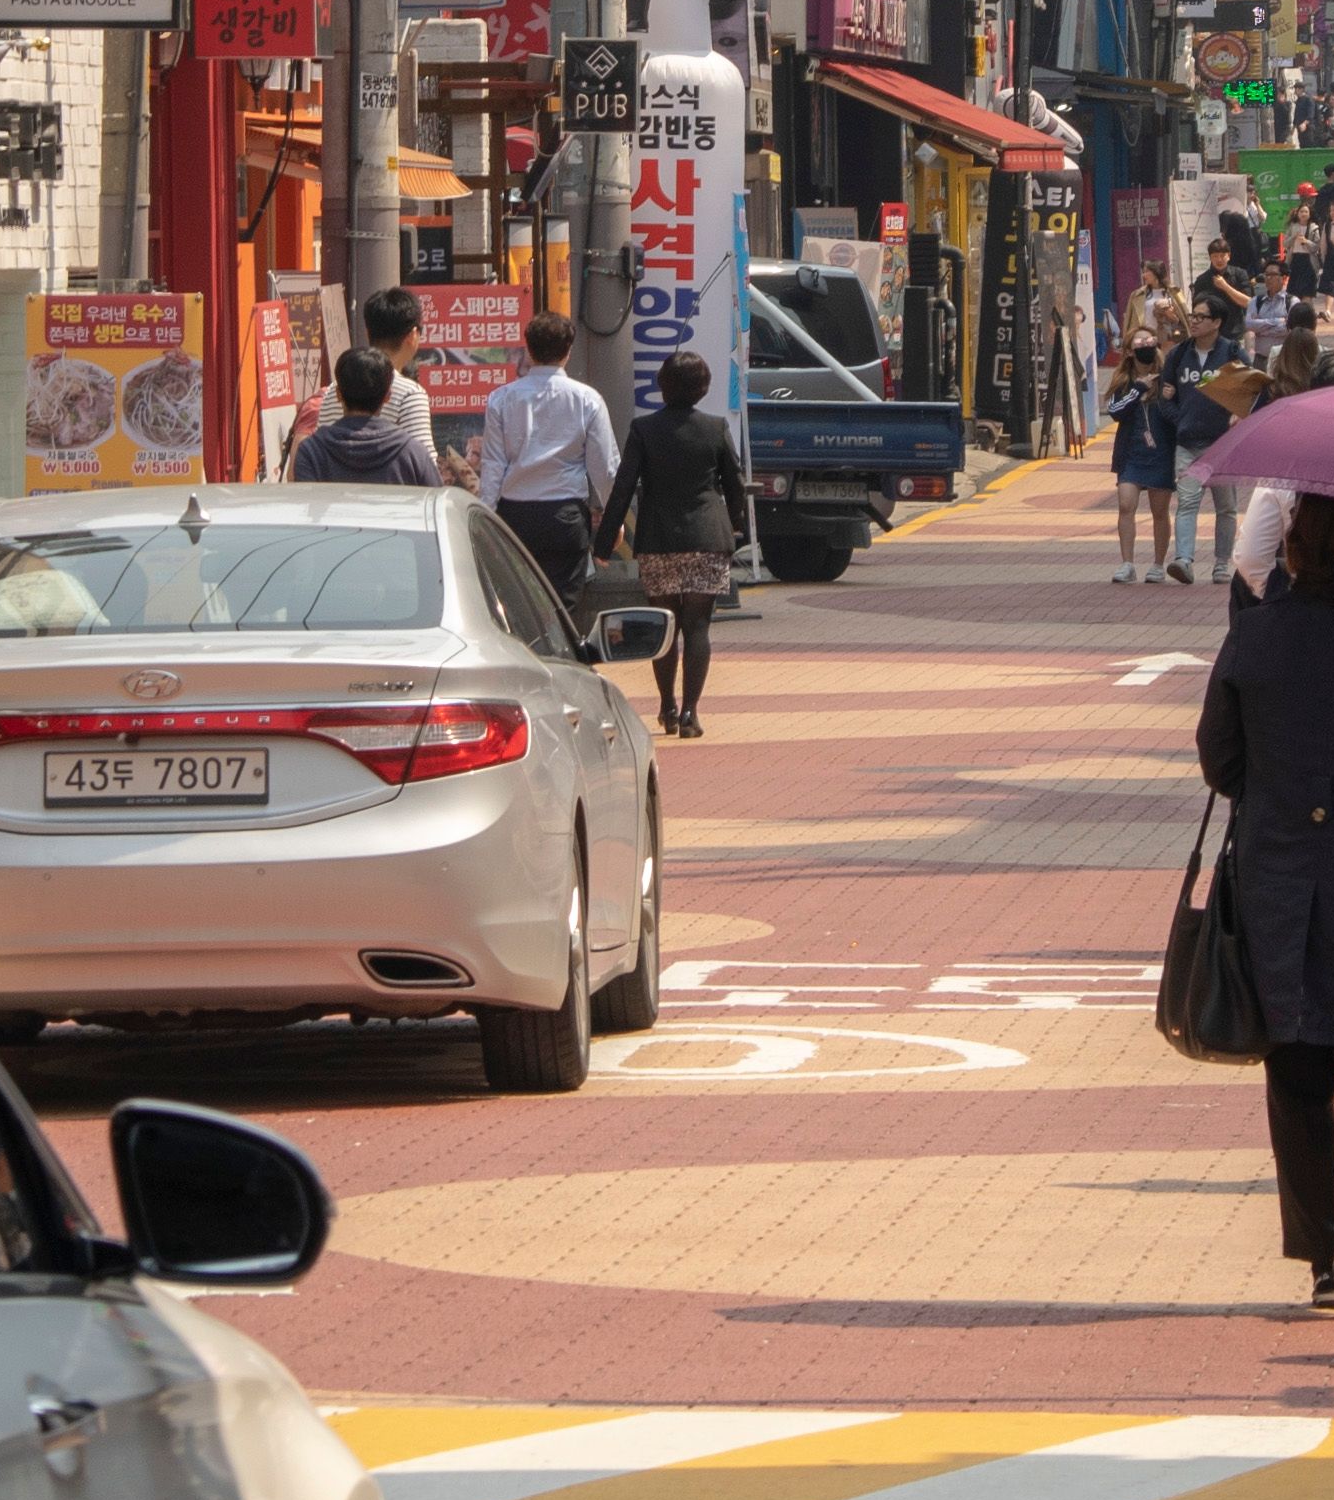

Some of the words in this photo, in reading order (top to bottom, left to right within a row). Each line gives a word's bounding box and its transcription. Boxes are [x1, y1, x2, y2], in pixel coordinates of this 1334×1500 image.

[209, 4, 298, 48] 생갈비
[575, 93, 629, 119] PUB
[49, 302, 83, 324] 직접
[86, 304, 128, 323] 우려낸
[131, 303, 179, 324] 육수와
[448, 295, 521, 318] 스페인풍
[49, 326, 91, 344] 쫀득한
[92, 323, 152, 344] 생면으로
[154, 326, 183, 344] 만든
[467, 322, 522, 343] 전문점
[477, 367, 508, 385] 육질
[813, 435, 884, 448] HYUNDAI
[36, 714, 272, 730] GRANDEUR
[64, 757, 134, 793] 43두
[152, 756, 248, 790] 7807
